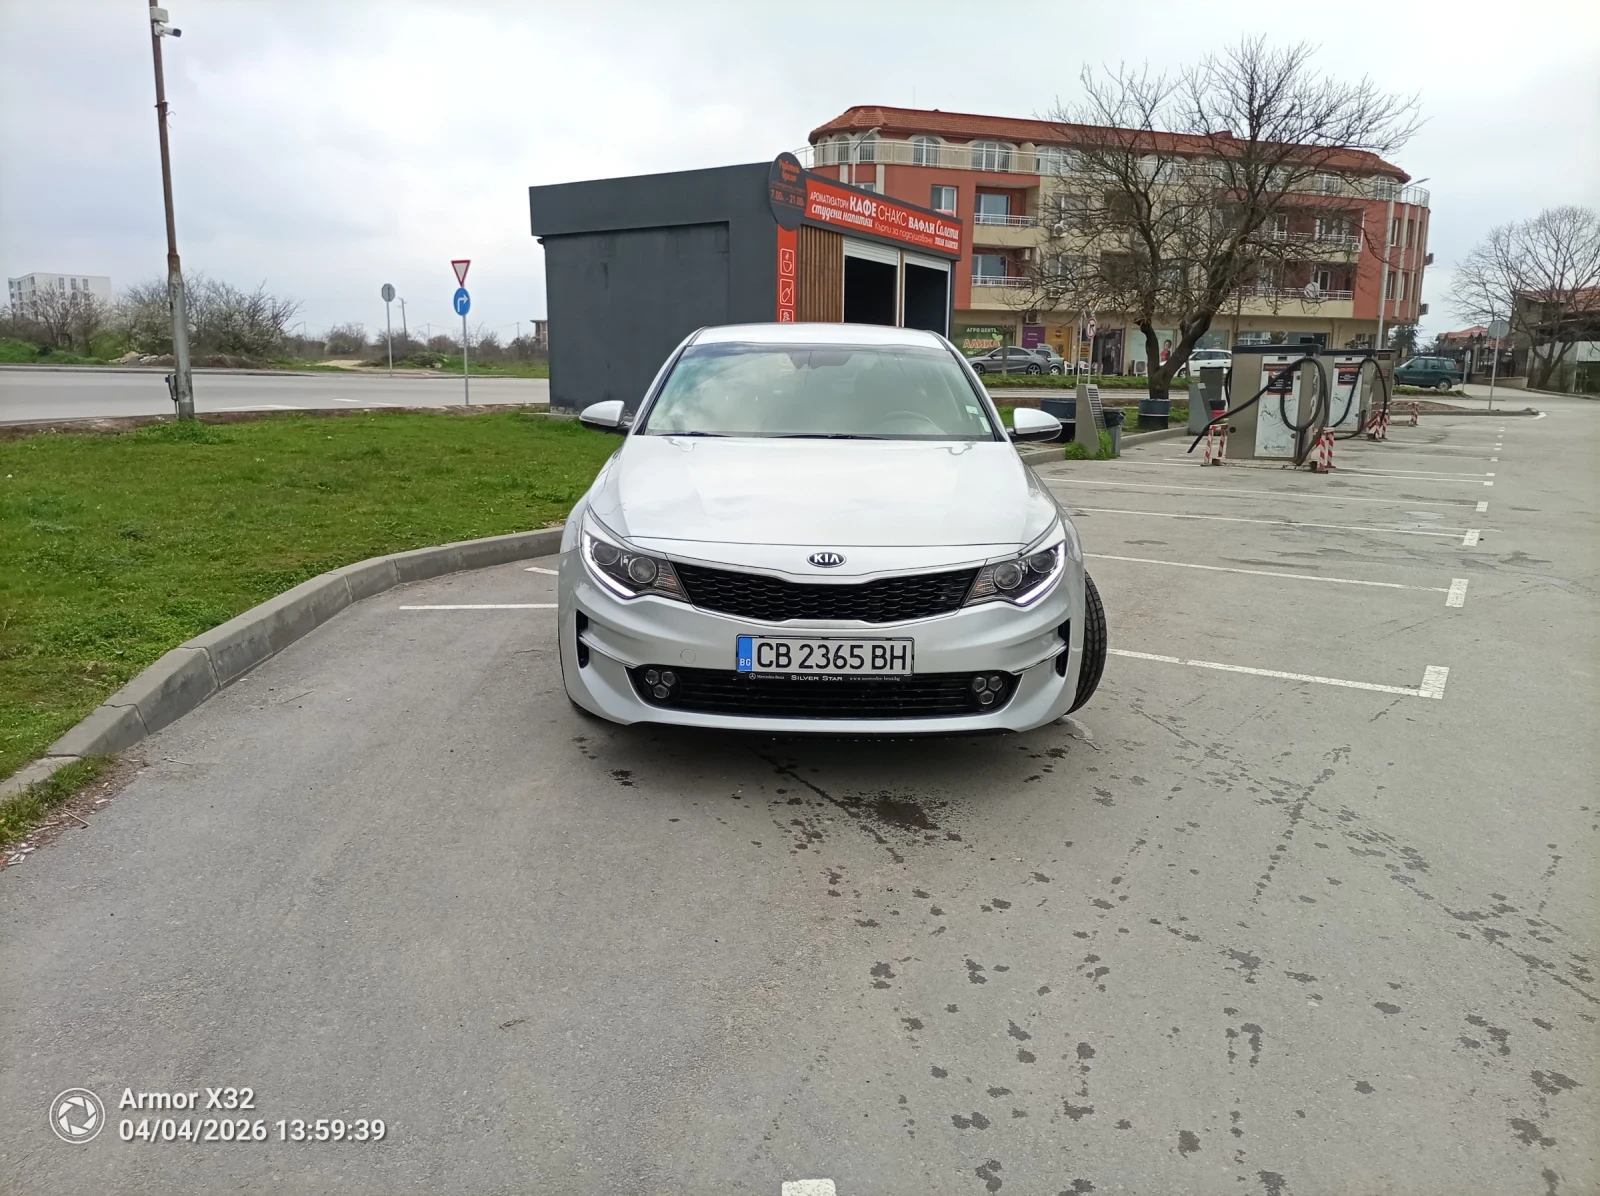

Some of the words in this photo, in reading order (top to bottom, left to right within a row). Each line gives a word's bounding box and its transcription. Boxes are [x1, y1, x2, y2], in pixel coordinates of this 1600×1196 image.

[811, 203, 843, 221] студени
[842, 211, 873, 228] напитки
[849, 195, 877, 217] КАФЕ
[877, 205, 907, 227] СНАКС
[908, 216, 935, 235] ВАФЛИ
[962, 338, 1001, 349] АЛИКА
[814, 553, 840, 563] KIA
[757, 642, 792, 669] CB
[798, 643, 865, 670] 2365
[871, 644, 907, 671] BH
[739, 658, 751, 667] BG
[790, 674, 819, 682] SILVER
